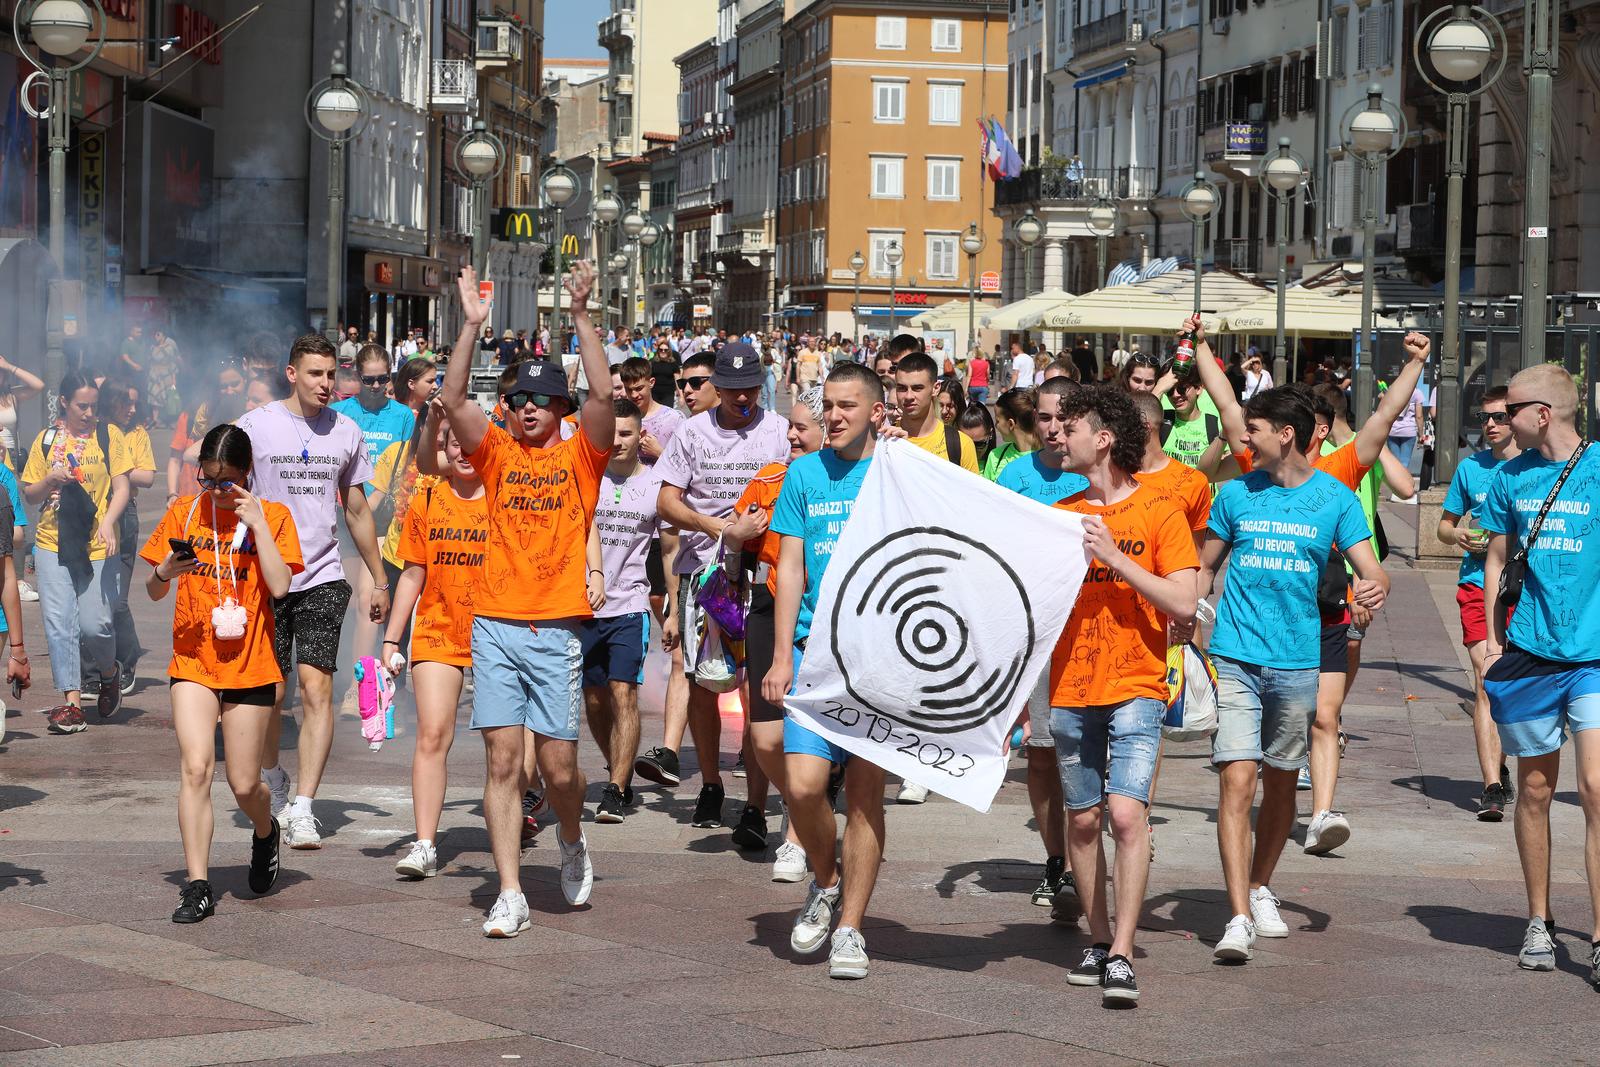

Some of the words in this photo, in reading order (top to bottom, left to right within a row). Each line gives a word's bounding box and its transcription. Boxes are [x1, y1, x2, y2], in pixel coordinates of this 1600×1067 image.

[84, 138, 100, 227] OTKUP
[895, 293, 927, 304] TISAK
[270, 455, 295, 464] VRHUNSKI
[1567, 447, 1583, 469] adidas
[723, 462, 734, 470] SMO
[296, 471, 307, 479] SMO
[505, 469, 568, 489] BARATAMO
[303, 486, 314, 495] SMO
[727, 491, 739, 499] SMO
[1547, 481, 1562, 503] adidas
[606, 509, 617, 518] SMO
[808, 501, 842, 517] RAGAZZI
[507, 513, 549, 529] MATE
[605, 523, 616, 532] SMO
[827, 521, 839, 534] AU
[1530, 516, 1542, 538] adidas
[1240, 521, 1270, 532] RAGAZZI
[1272, 522, 1318, 538] TRANQUILO
[1254, 538, 1264, 550] AU
[1265, 539, 1297, 555] REVOIR,
[1552, 538, 1562, 550] JE
[1563, 538, 1582, 552] BILO
[433, 552, 484, 567] JEZICIM
[1240, 552, 1262, 568] SCHÖN
[1263, 557, 1282, 570] NAM
[1284, 559, 1294, 572] JE
[1294, 560, 1311, 573] BILO
[820, 700, 975, 777] 2019-2023
